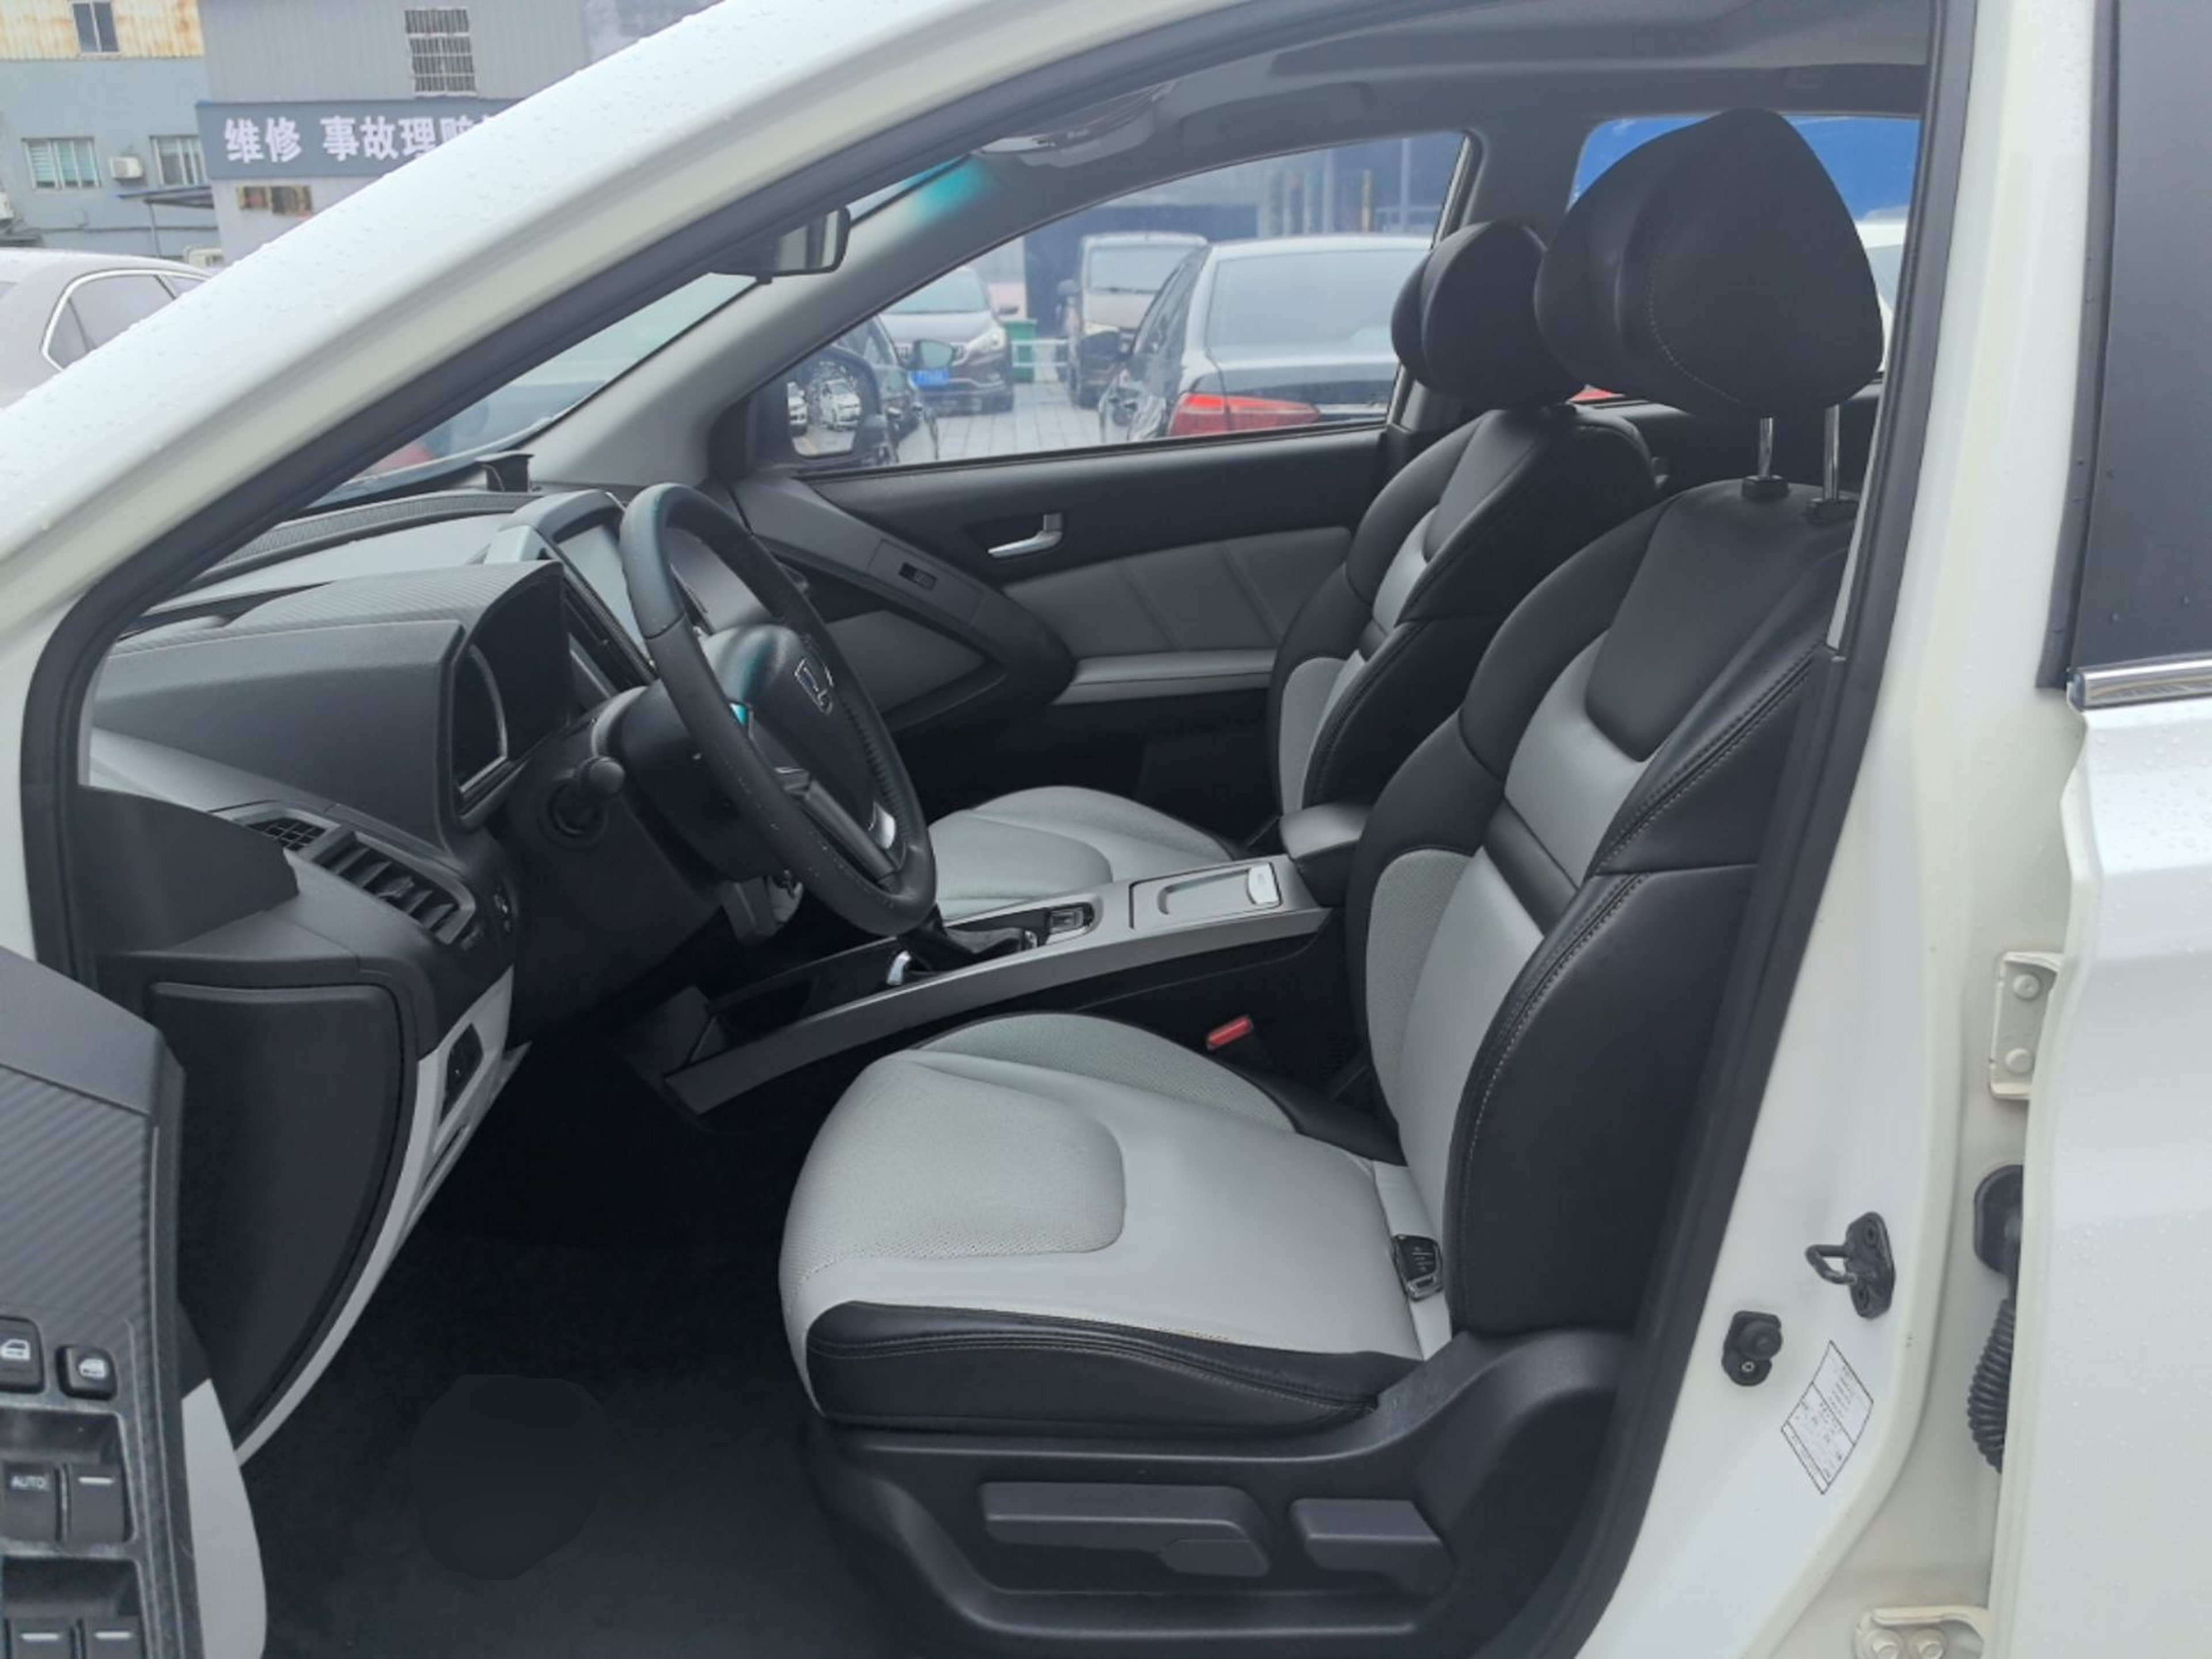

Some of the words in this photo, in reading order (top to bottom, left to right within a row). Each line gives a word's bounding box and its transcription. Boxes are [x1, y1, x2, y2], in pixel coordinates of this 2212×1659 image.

[224, 118, 302, 164] 维修
[320, 115, 488, 162] 事故理
[12, 1475, 47, 1490] AUTO
